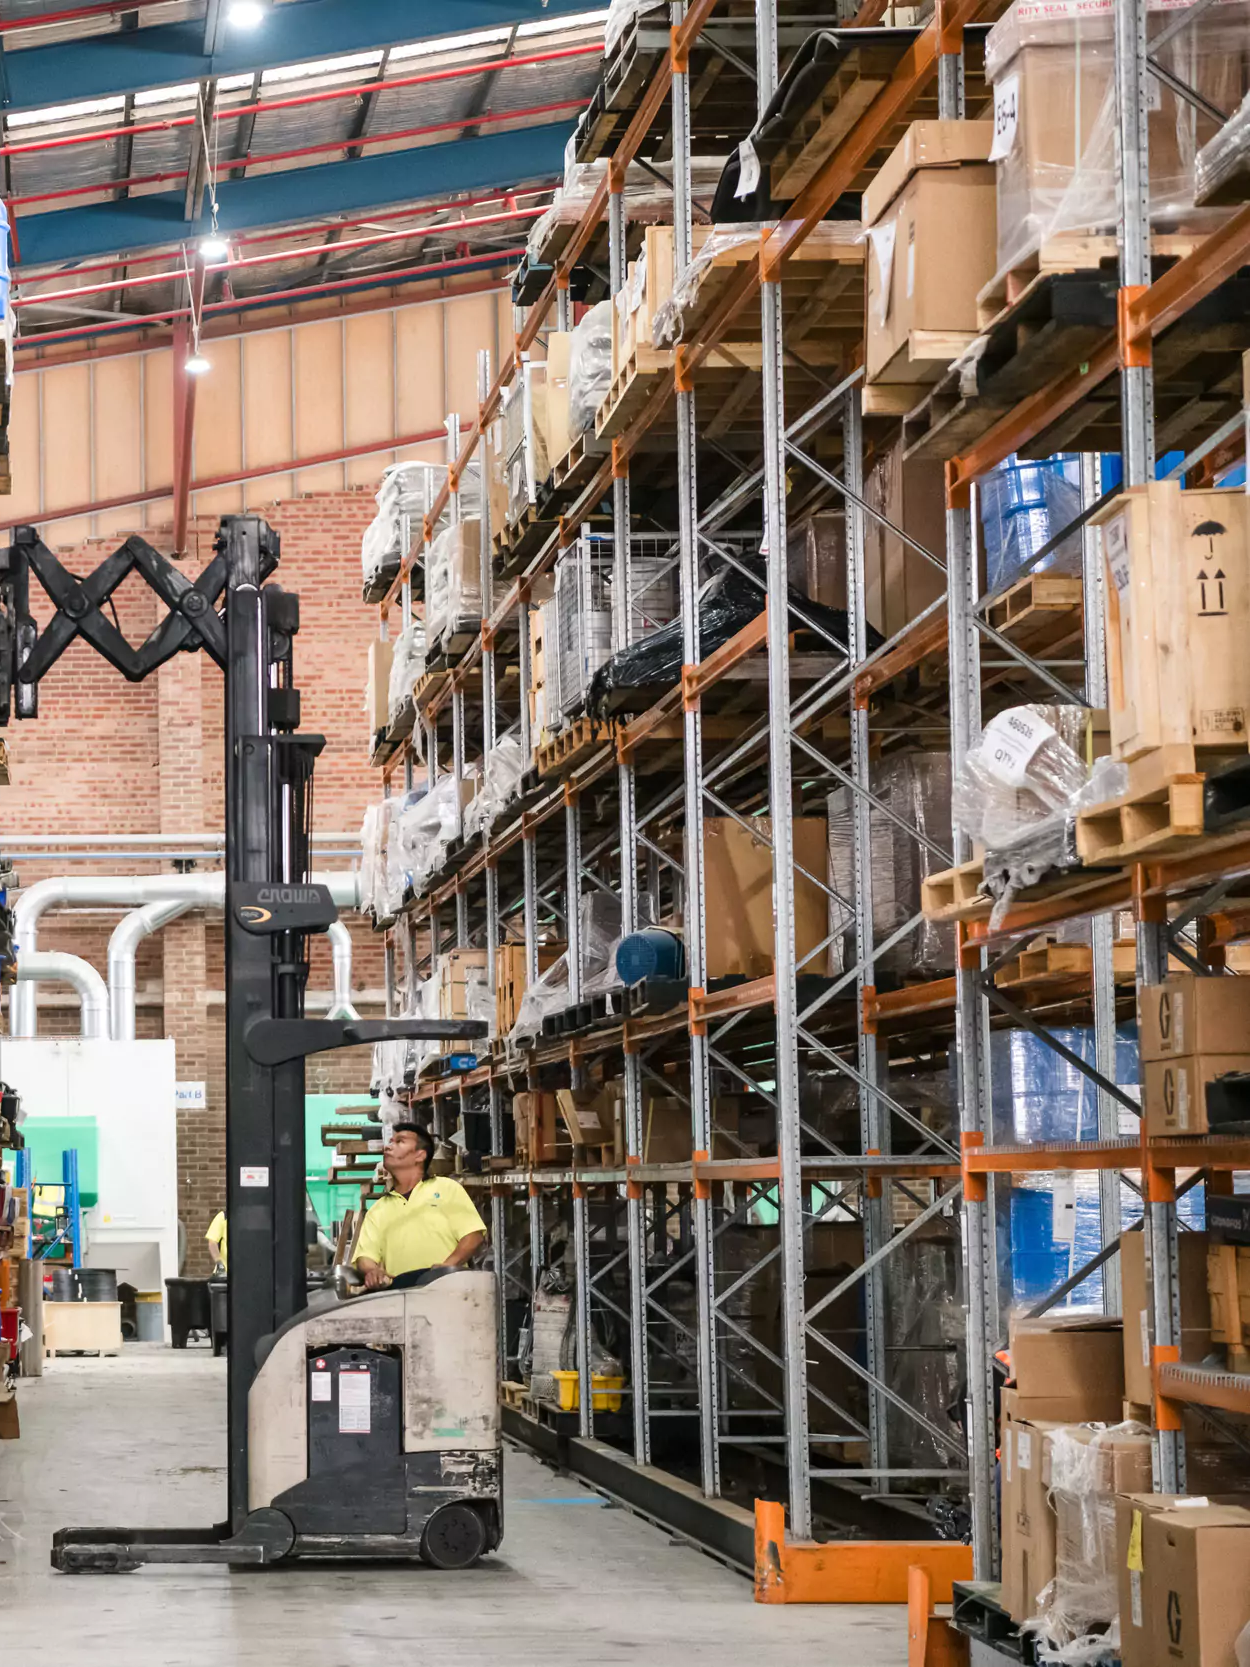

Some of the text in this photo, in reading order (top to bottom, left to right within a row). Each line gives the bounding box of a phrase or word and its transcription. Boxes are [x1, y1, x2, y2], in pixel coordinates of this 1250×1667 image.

[1044, 4, 1067, 13] SEAL
[257, 888, 321, 904] CROWN
[194, 1089, 202, 1099] B
